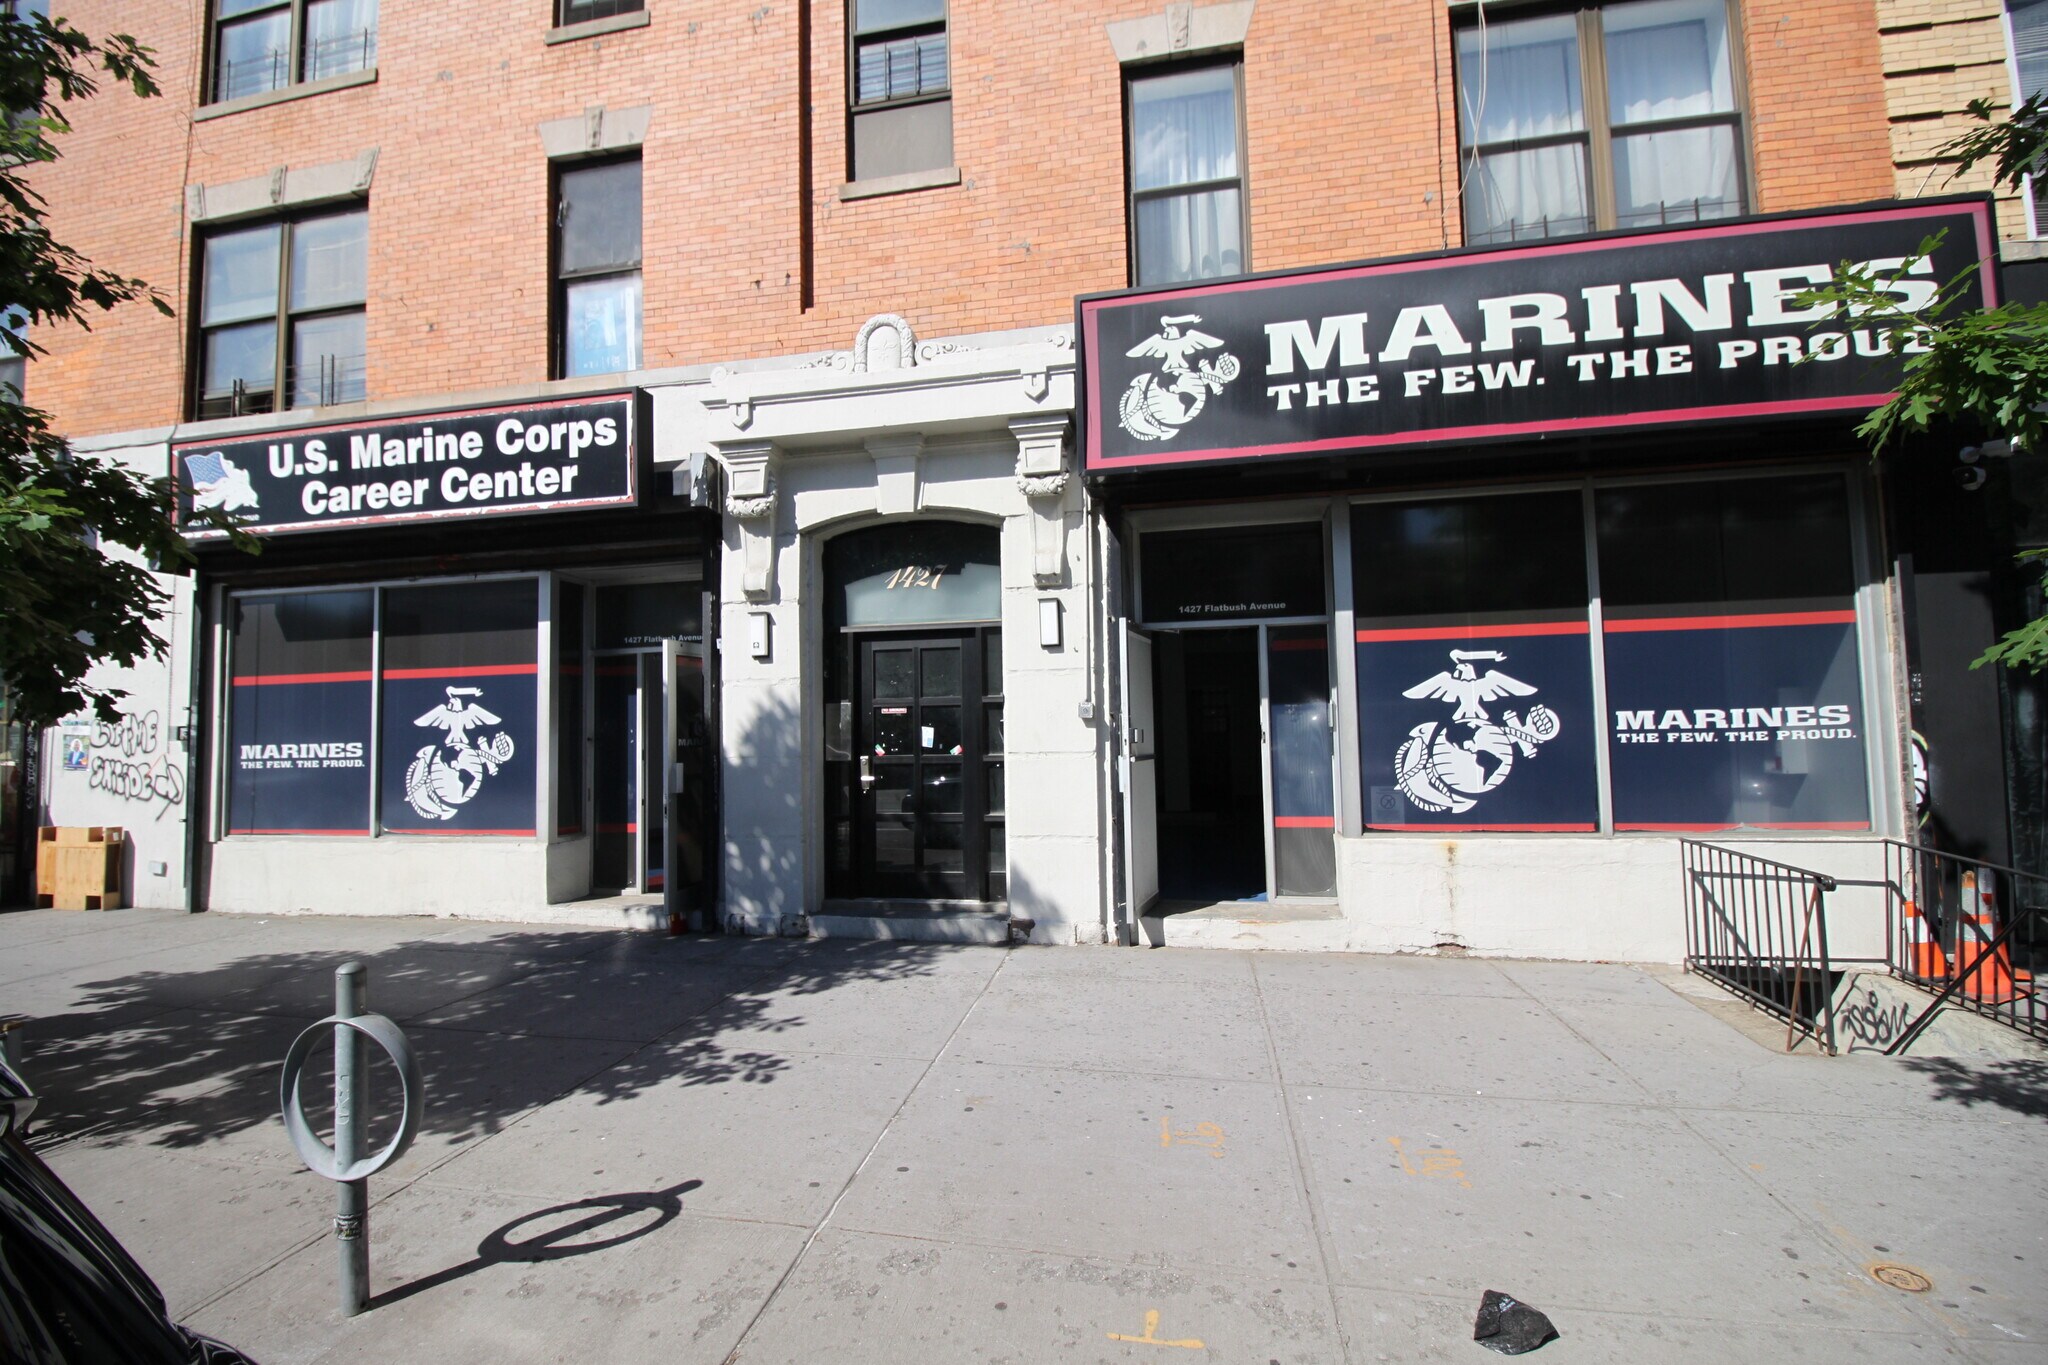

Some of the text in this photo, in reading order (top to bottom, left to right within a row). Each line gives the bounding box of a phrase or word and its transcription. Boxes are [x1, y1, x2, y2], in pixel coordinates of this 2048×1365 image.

[1264, 254, 1940, 376] MARINES
[1266, 375, 1379, 411] THE
[1403, 359, 1545, 398] FEW.
[1566, 344, 1693, 382] THE
[268, 416, 618, 478] U.S. Marine Corps
[301, 461, 579, 515] Career Center
[883, 563, 949, 590] 1427
[1178, 602, 1287, 614] 1427 Flatbush Avenue
[623, 636, 642, 644] 1427
[1615, 704, 1851, 731] MARINES
[1617, 728, 1857, 743] THE FEW. THE PROUD.
[240, 742, 363, 760] MARINES
[240, 759, 365, 769] THE FEW. THE PROUD.
